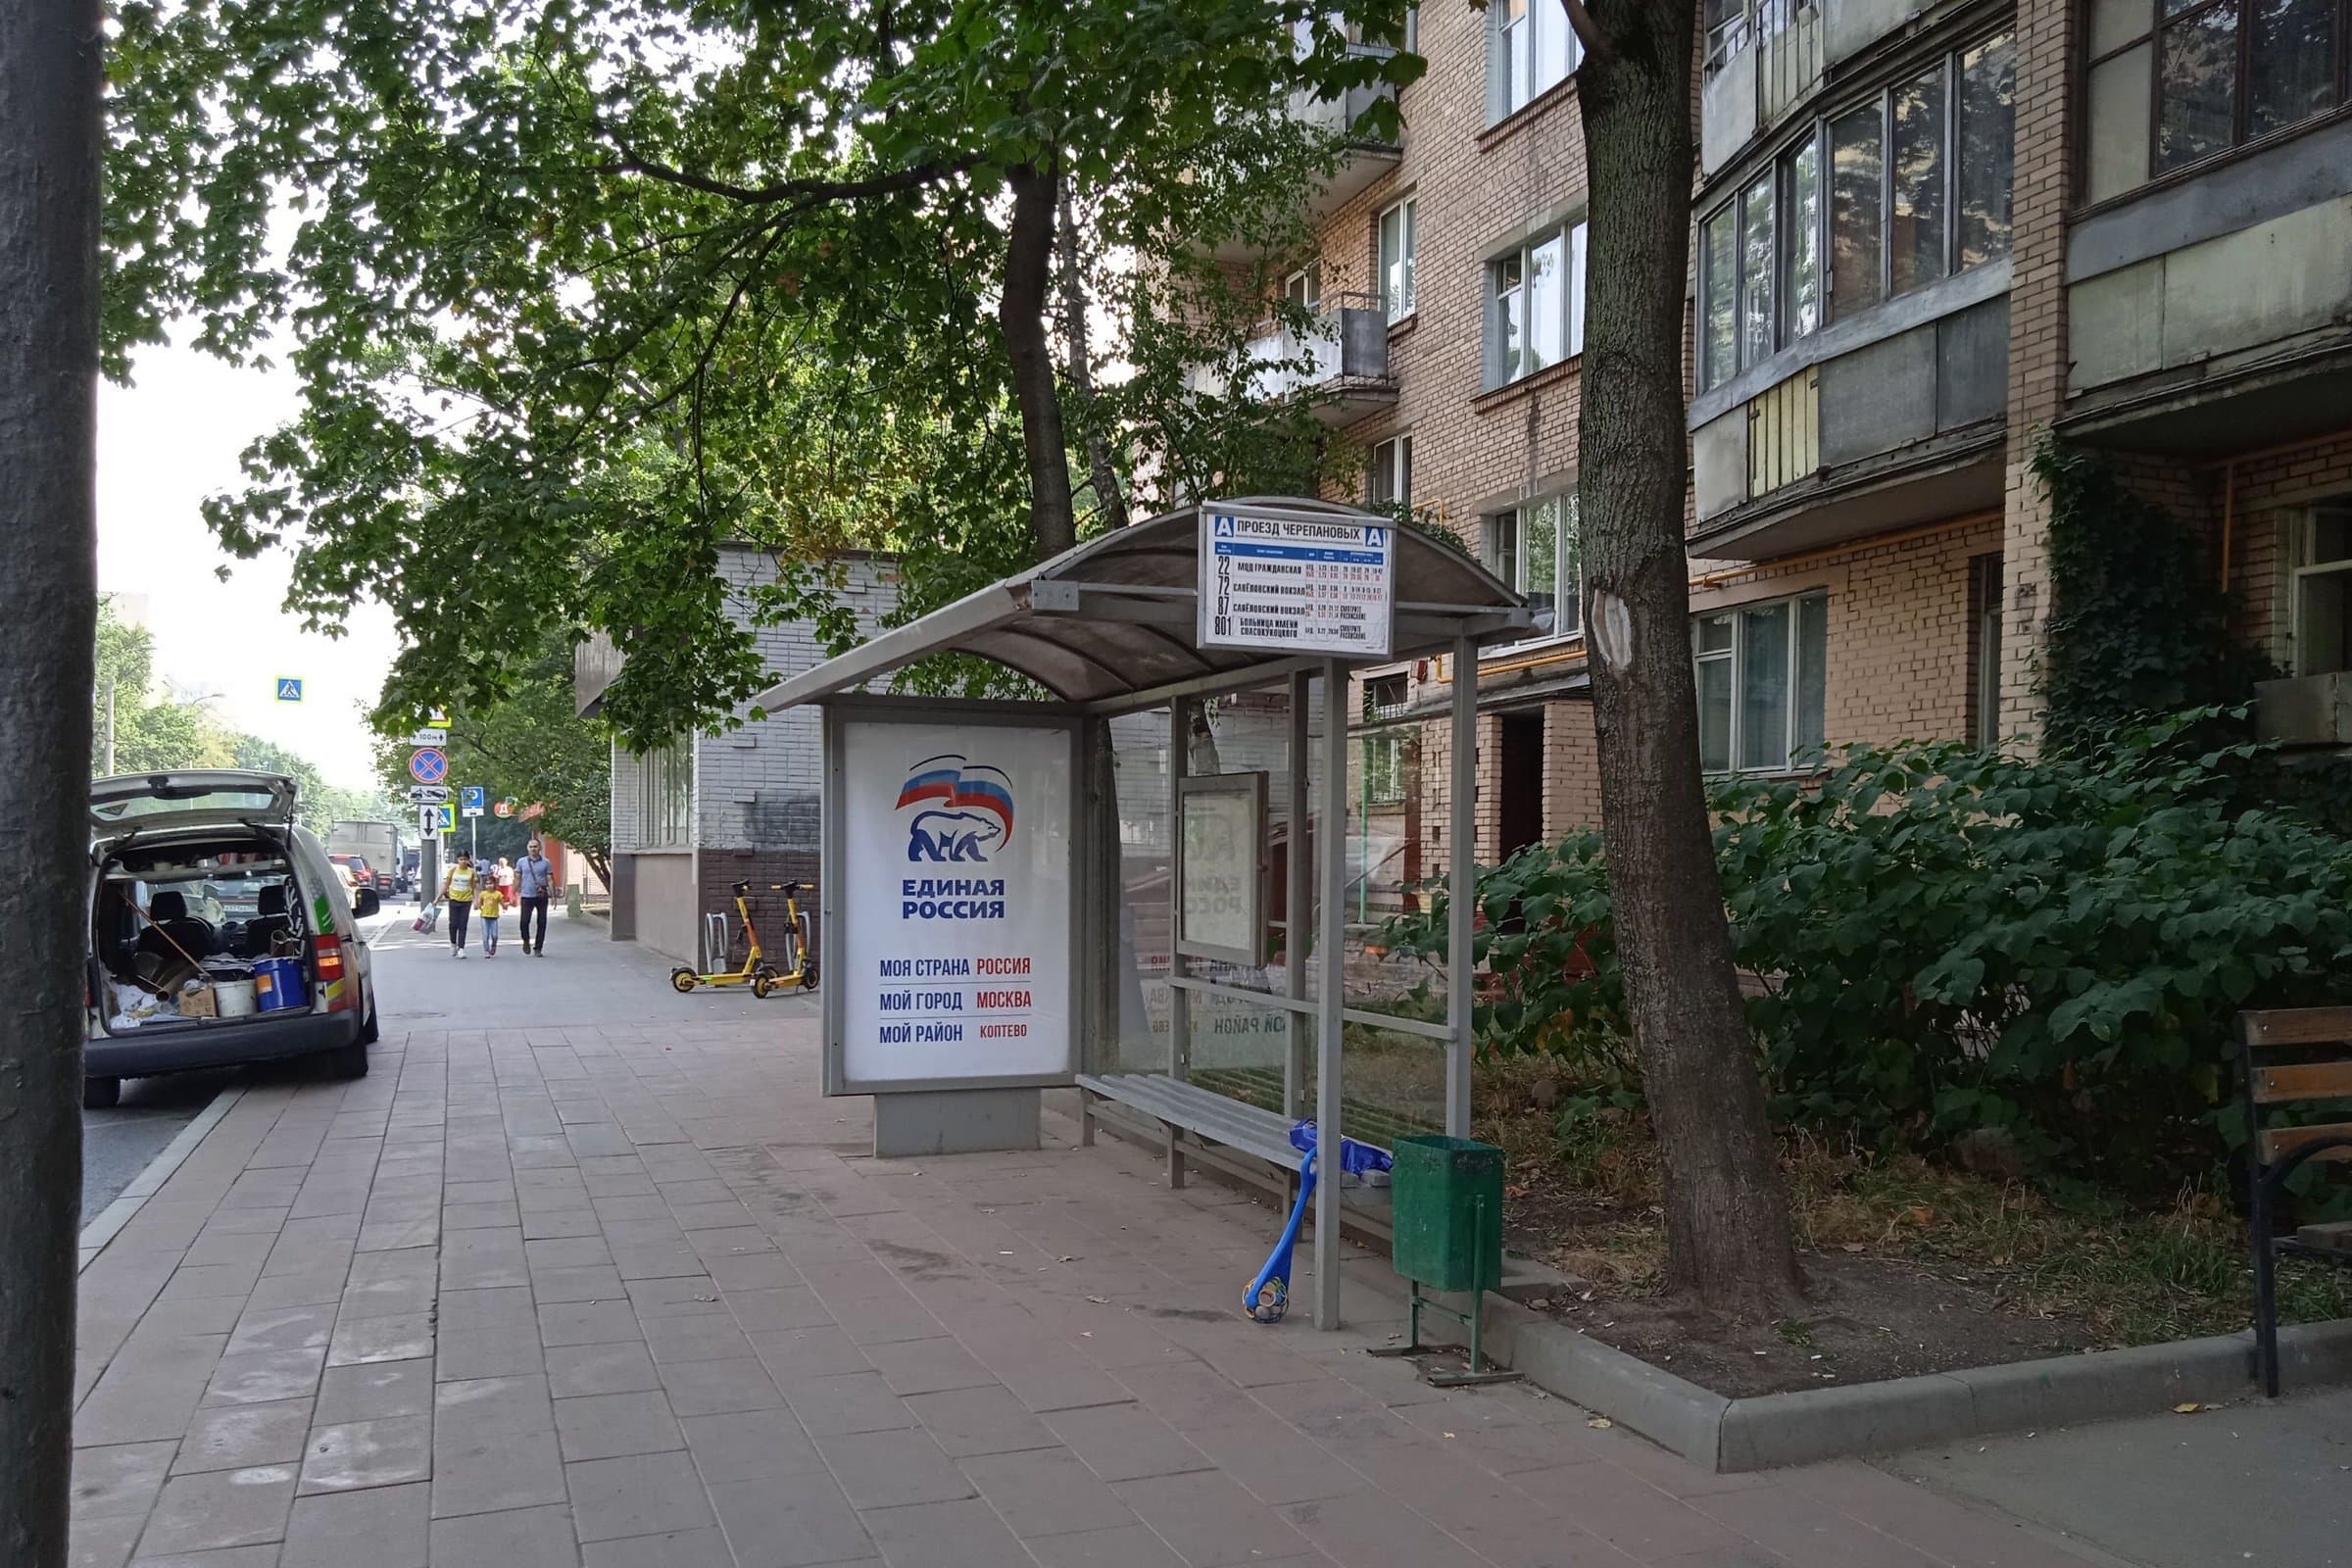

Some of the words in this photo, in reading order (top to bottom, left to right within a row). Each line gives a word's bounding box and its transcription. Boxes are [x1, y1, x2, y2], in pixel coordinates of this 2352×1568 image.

[1237, 520, 1280, 536] ПРОЕЗД
[1283, 523, 1360, 540] ЧЕРЕПАНОВЫХ
[1218, 556, 1230, 575] 22
[1254, 563, 1302, 574] ГРАЖДАНСКАЯ
[1218, 575, 1230, 596] 72
[1280, 586, 1305, 596] ВОКЗАЛ
[1218, 596, 1230, 615] 87
[1280, 606, 1305, 615] ВОКЗАЛ
[1215, 615, 1231, 636] 801
[1240, 617, 1274, 627] БОЛЬНИЦА
[1275, 619, 1298, 628] ИМЕНИ
[903, 879, 1004, 899] ЕДИНАЯ
[903, 901, 1004, 919] РОССИЯ
[880, 959, 911, 977] МОЯ
[916, 958, 970, 976] СТРАНА
[977, 956, 1031, 975] РОССИЯ
[880, 990, 911, 1011] МОЙ
[916, 992, 962, 1011] ГОРОД
[977, 991, 1032, 1008] МОСКВА
[880, 1022, 911, 1044] МОЙ
[916, 1020, 962, 1043] РАЙОН
[980, 1024, 1027, 1039] КОПТЕВО
